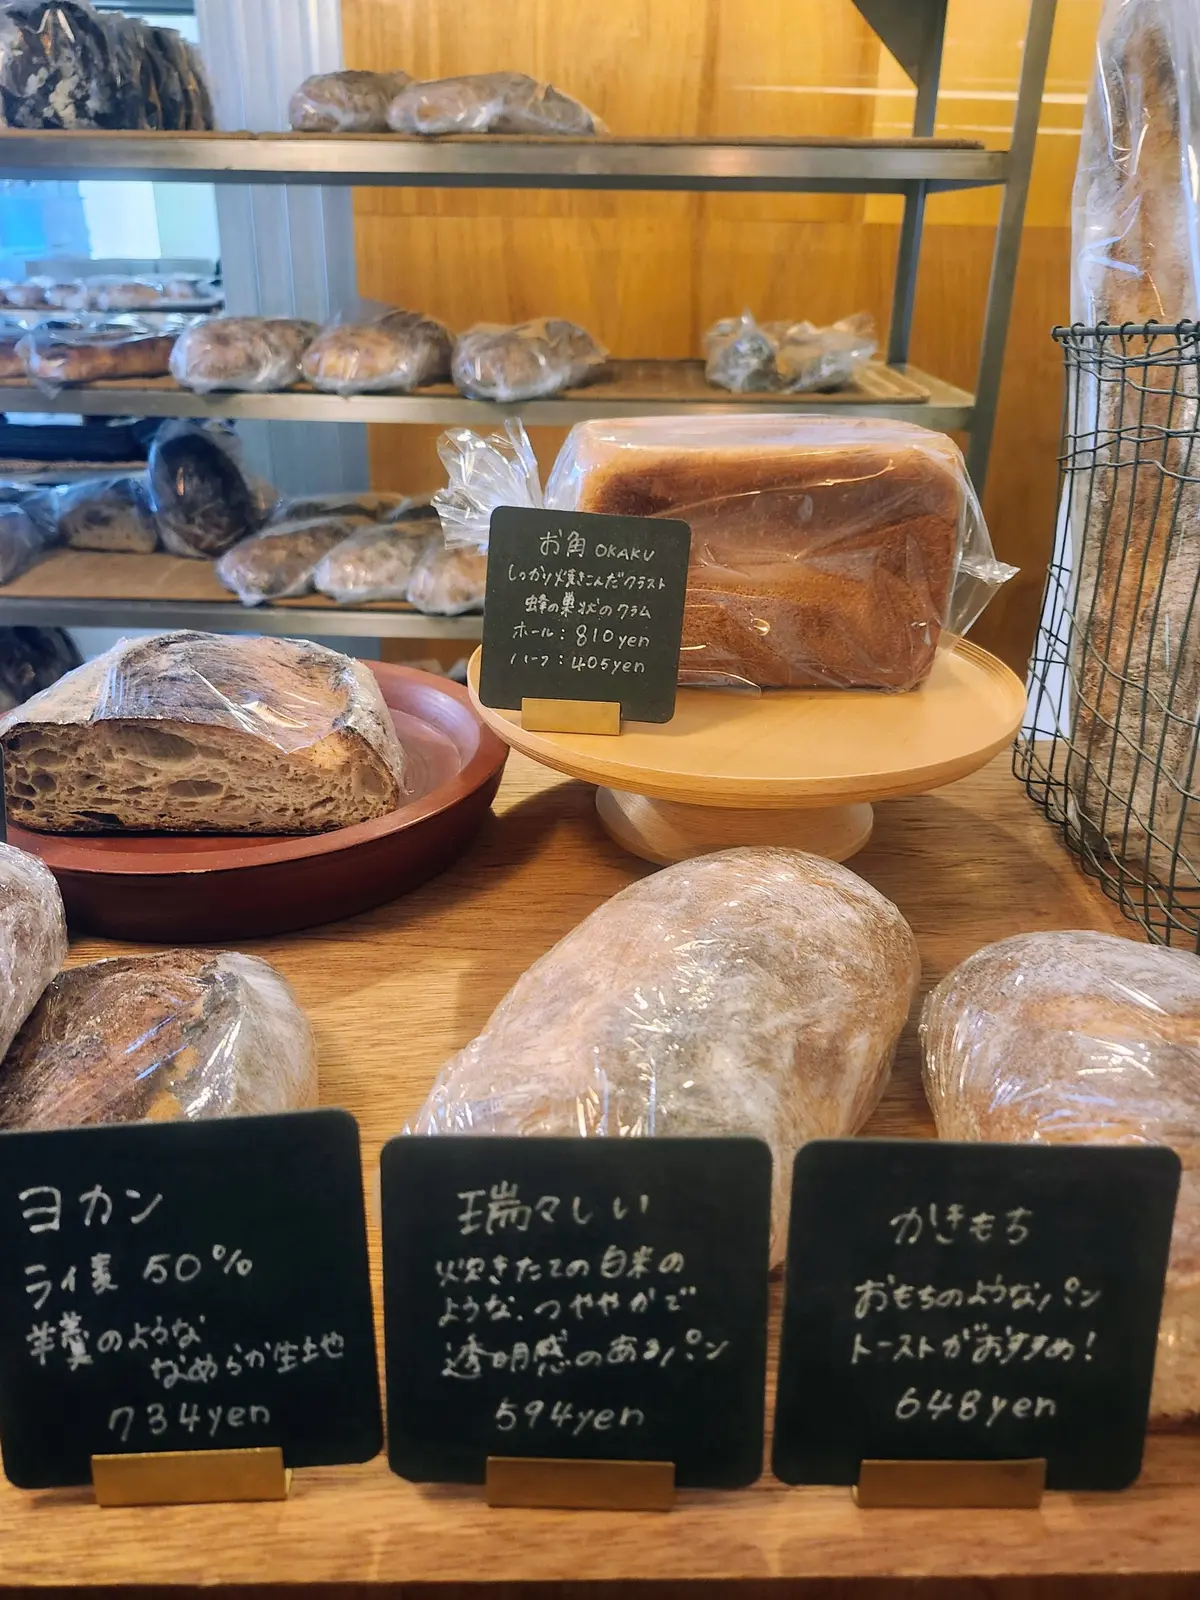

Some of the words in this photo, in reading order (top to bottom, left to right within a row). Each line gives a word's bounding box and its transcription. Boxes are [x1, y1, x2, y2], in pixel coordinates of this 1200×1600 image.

[539, 529, 586, 558] お角
[594, 543, 656, 562] OKAKU
[524, 590, 652, 619] 蜂の巣状のクラム
[18, 1183, 164, 1234] ヨカン
[456, 1179, 649, 1236] 瑞々しい
[889, 1202, 1033, 1246] かきもち
[24, 1252, 119, 1310] ライ麦
[142, 1243, 253, 1285] 50%
[854, 1273, 1101, 1320] おもちのようなパン
[150, 1330, 346, 1390] なめらか生地
[440, 1328, 730, 1379] 透明感のあるパン
[108, 1401, 271, 1442] 734yen
[494, 1397, 646, 1436] 594yen
[895, 1386, 1057, 1428] 648yen
